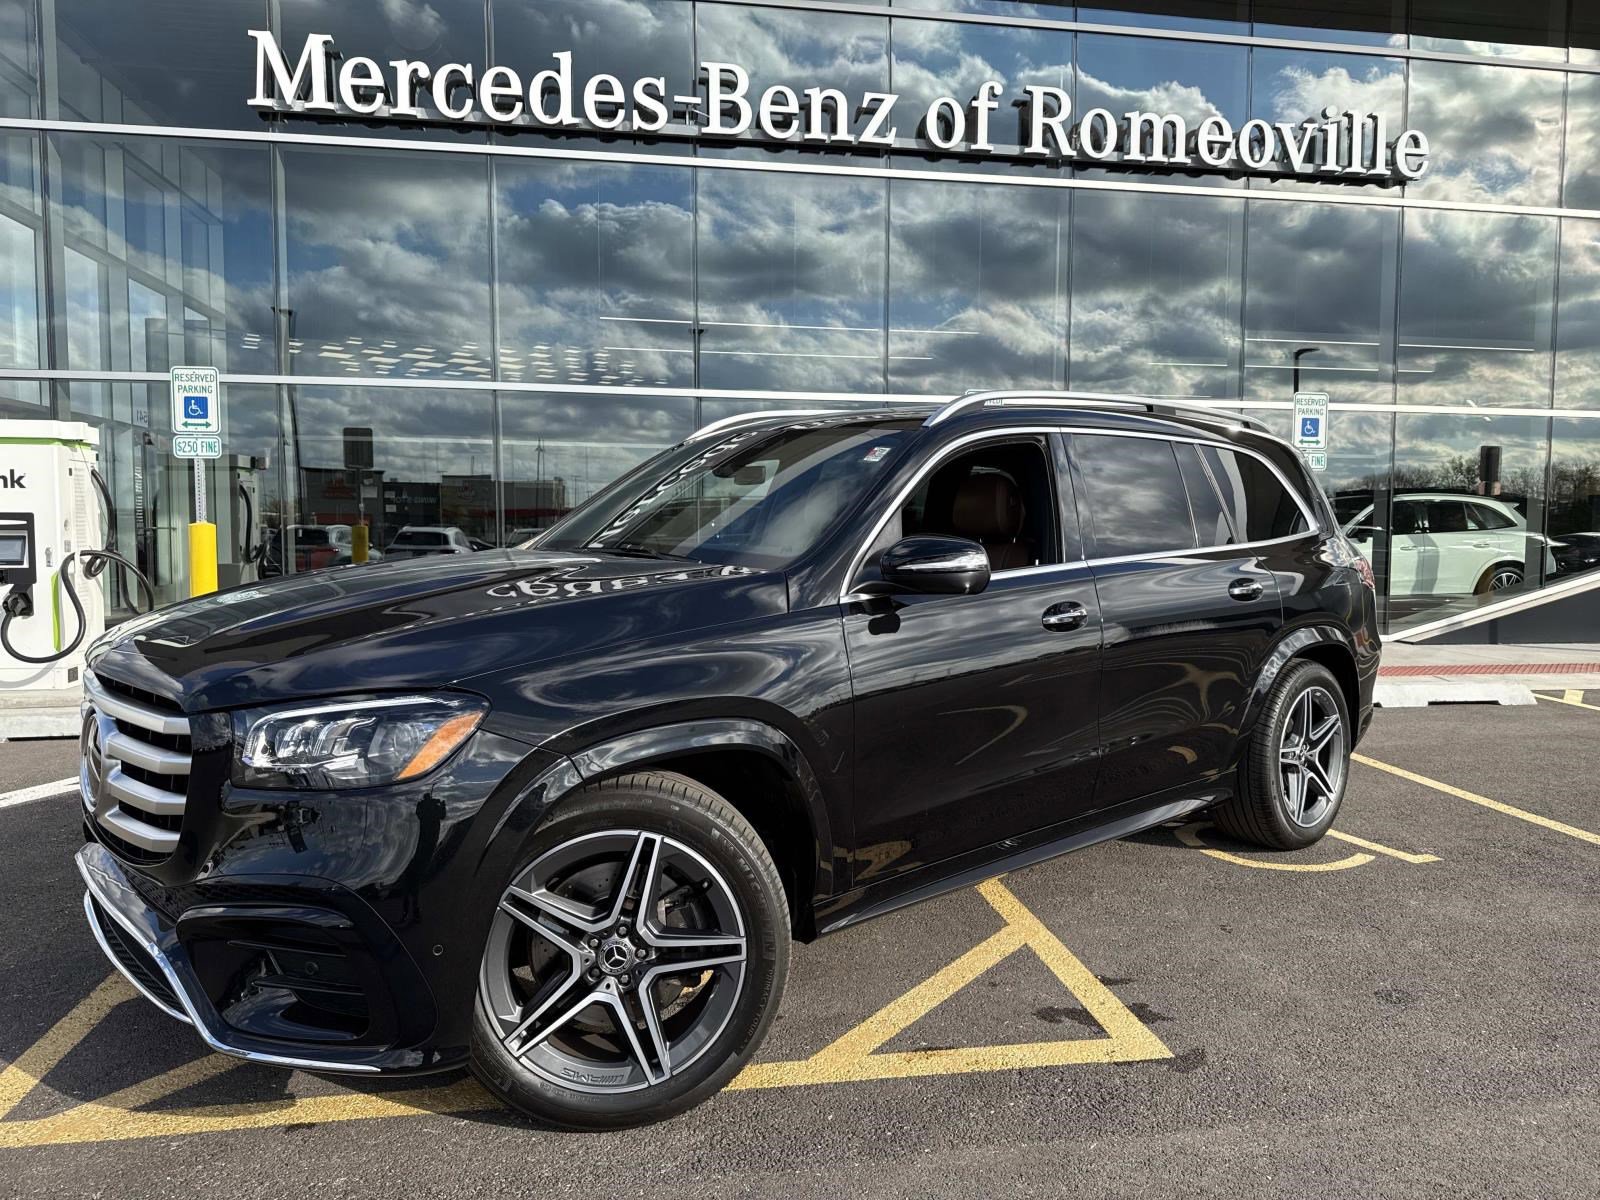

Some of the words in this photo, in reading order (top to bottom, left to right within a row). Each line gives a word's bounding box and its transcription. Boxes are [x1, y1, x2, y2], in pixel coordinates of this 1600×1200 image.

[246, 29, 898, 145] Mercedes-Benz
[926, 81, 1003, 151] of
[1024, 85, 1431, 180] Romeoville
[174, 373, 215, 383] RESERVED
[177, 385, 213, 394] PARKING
[1296, 398, 1326, 407] RESERVED
[1297, 407, 1324, 416] PARKING
[176, 441, 198, 454] $250
[200, 441, 218, 454] FINE
[1311, 455, 1324, 467] FINE
